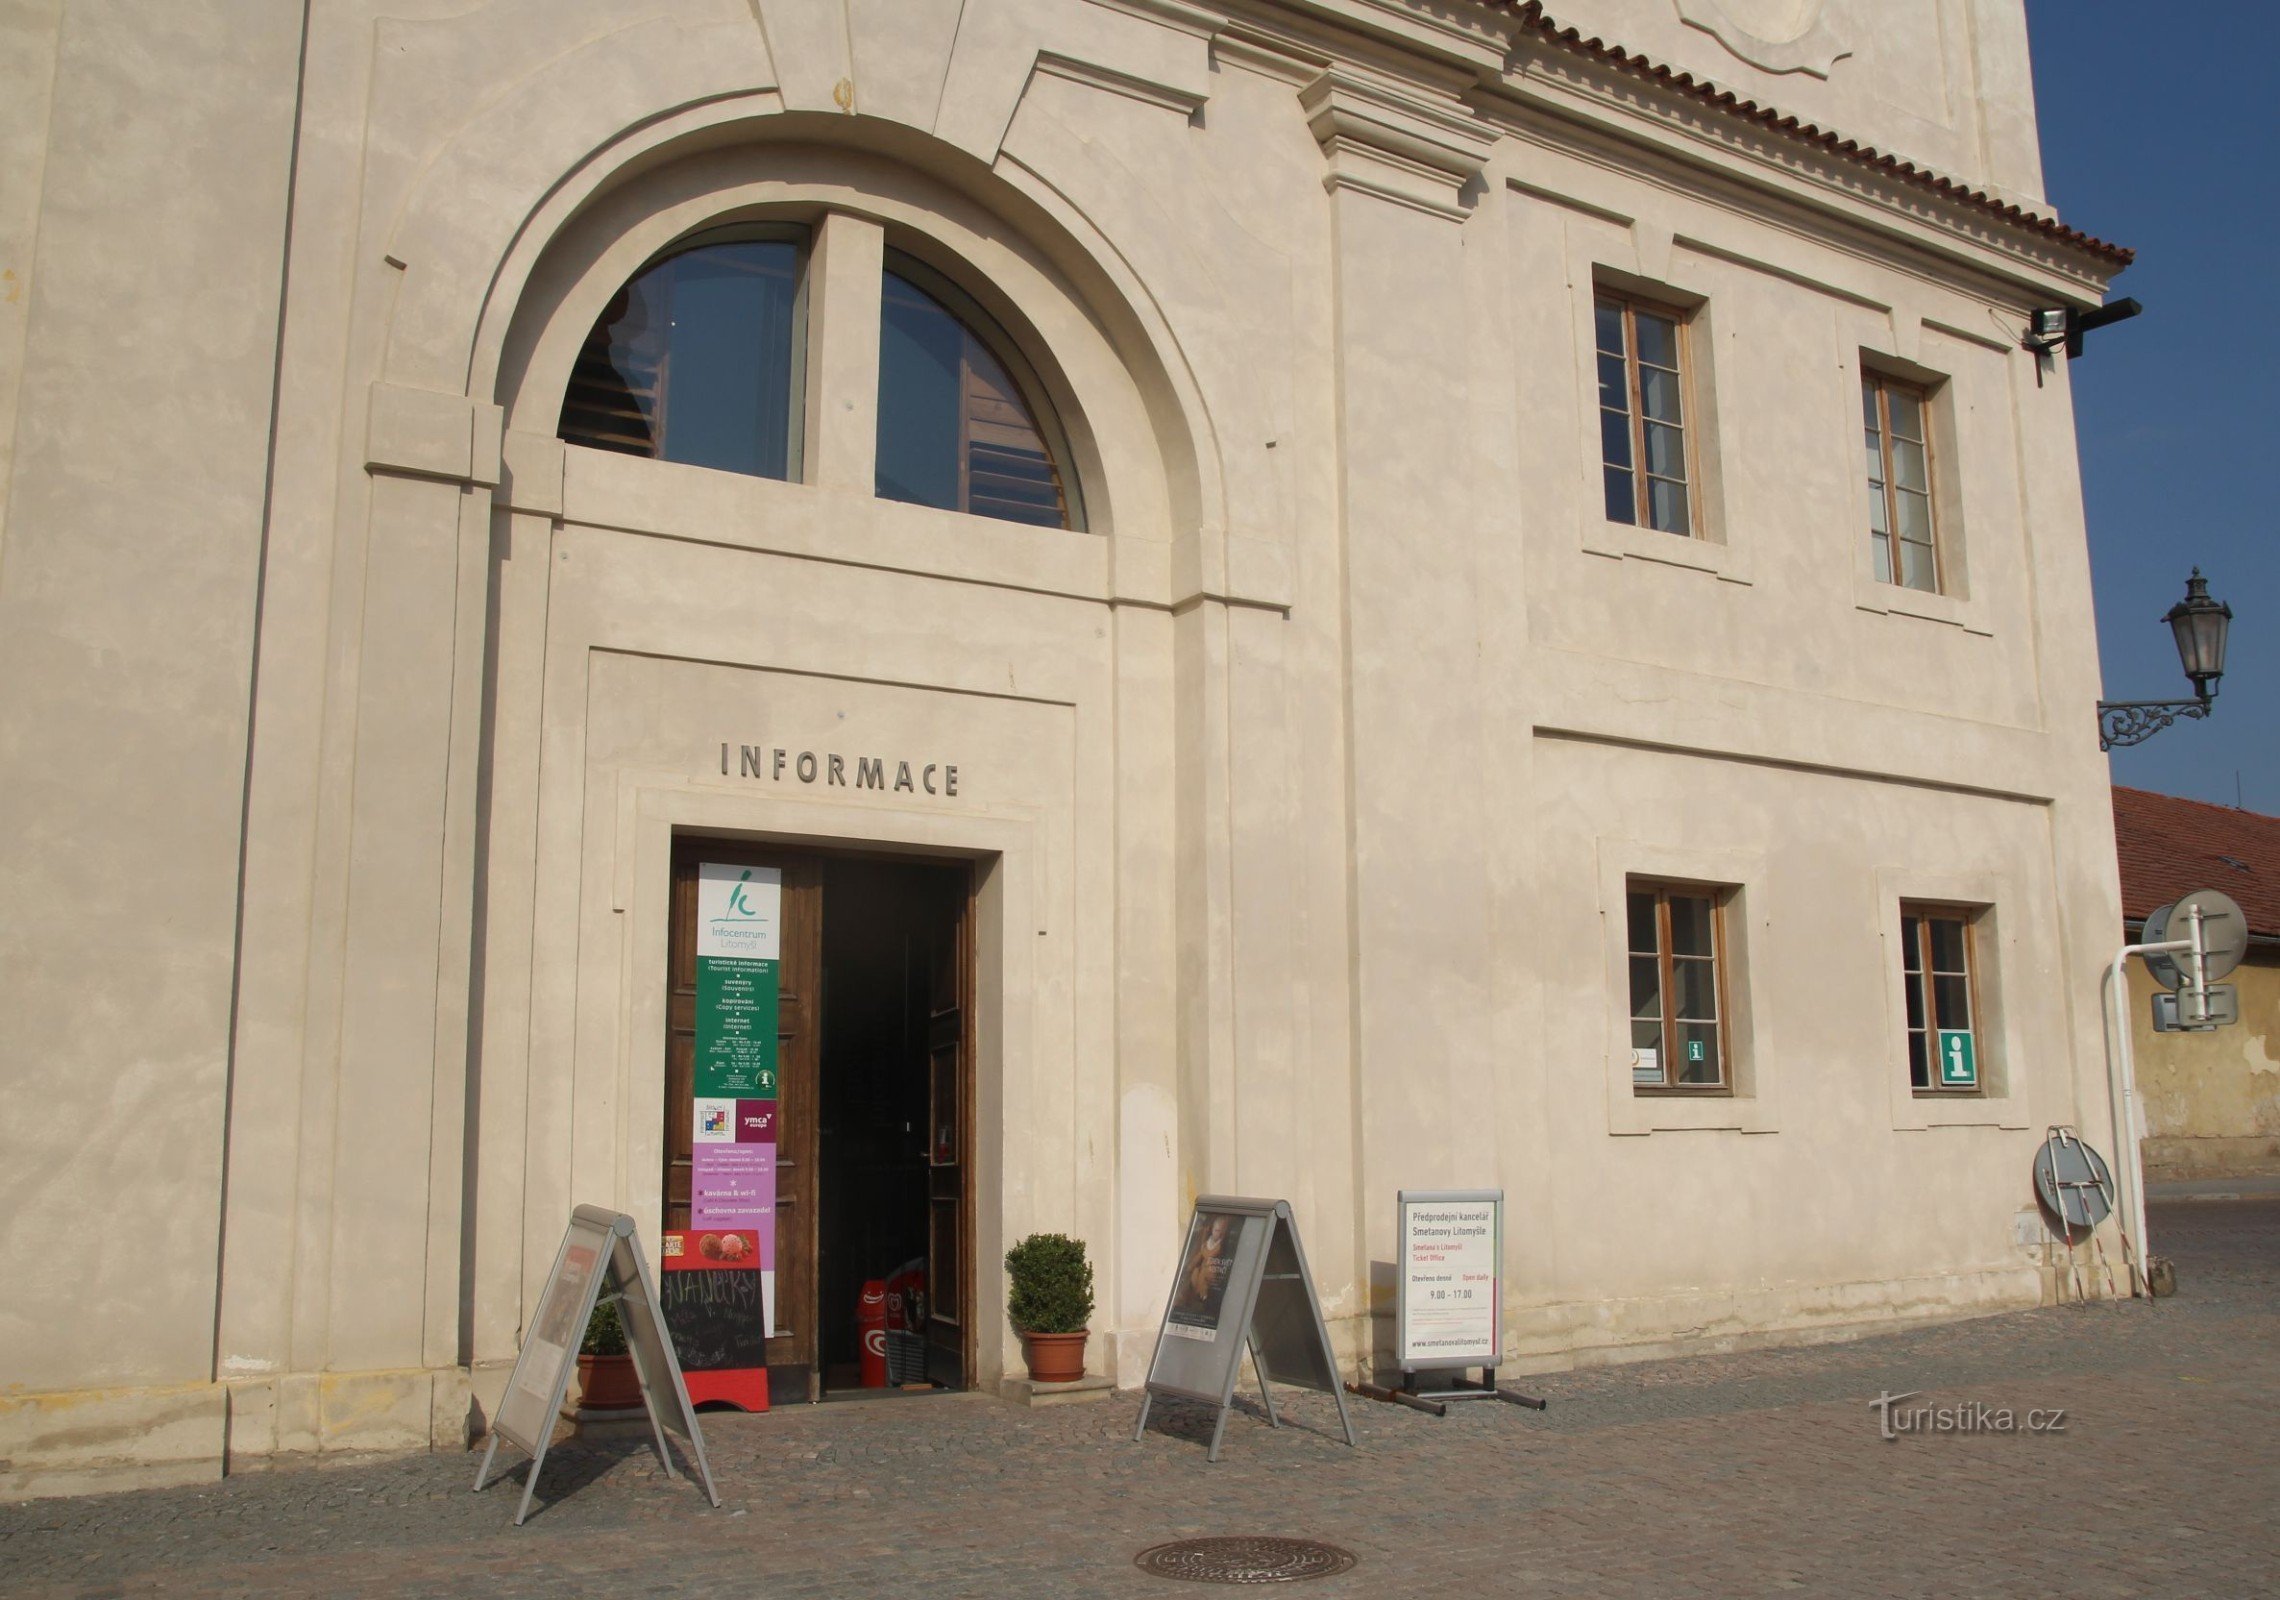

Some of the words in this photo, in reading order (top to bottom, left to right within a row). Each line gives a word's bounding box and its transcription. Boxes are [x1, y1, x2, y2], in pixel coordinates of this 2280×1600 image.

[721, 742, 958, 797] INFORMACE
[712, 926, 767, 940] Infocentrum
[744, 1116, 767, 1126] ymca
[703, 1189, 732, 1197] kavárna
[740, 1189, 756, 1197] wi-fi
[703, 1206, 736, 1215] úschovna
[737, 1205, 771, 1214] zavazadel
[1412, 1212, 1458, 1224] Předprodejní
[1459, 1211, 1489, 1222] kancelář
[1412, 1226, 1451, 1238] Smetanovy
[1453, 1226, 1487, 1237] Litomyšle
[1412, 1254, 1429, 1262] Ticket
[1429, 1254, 1445, 1262] Office
[1462, 1274, 1475, 1283] Open
[1430, 1290, 1445, 1300] 9.00
[1453, 1289, 1472, 1299] 17.00
